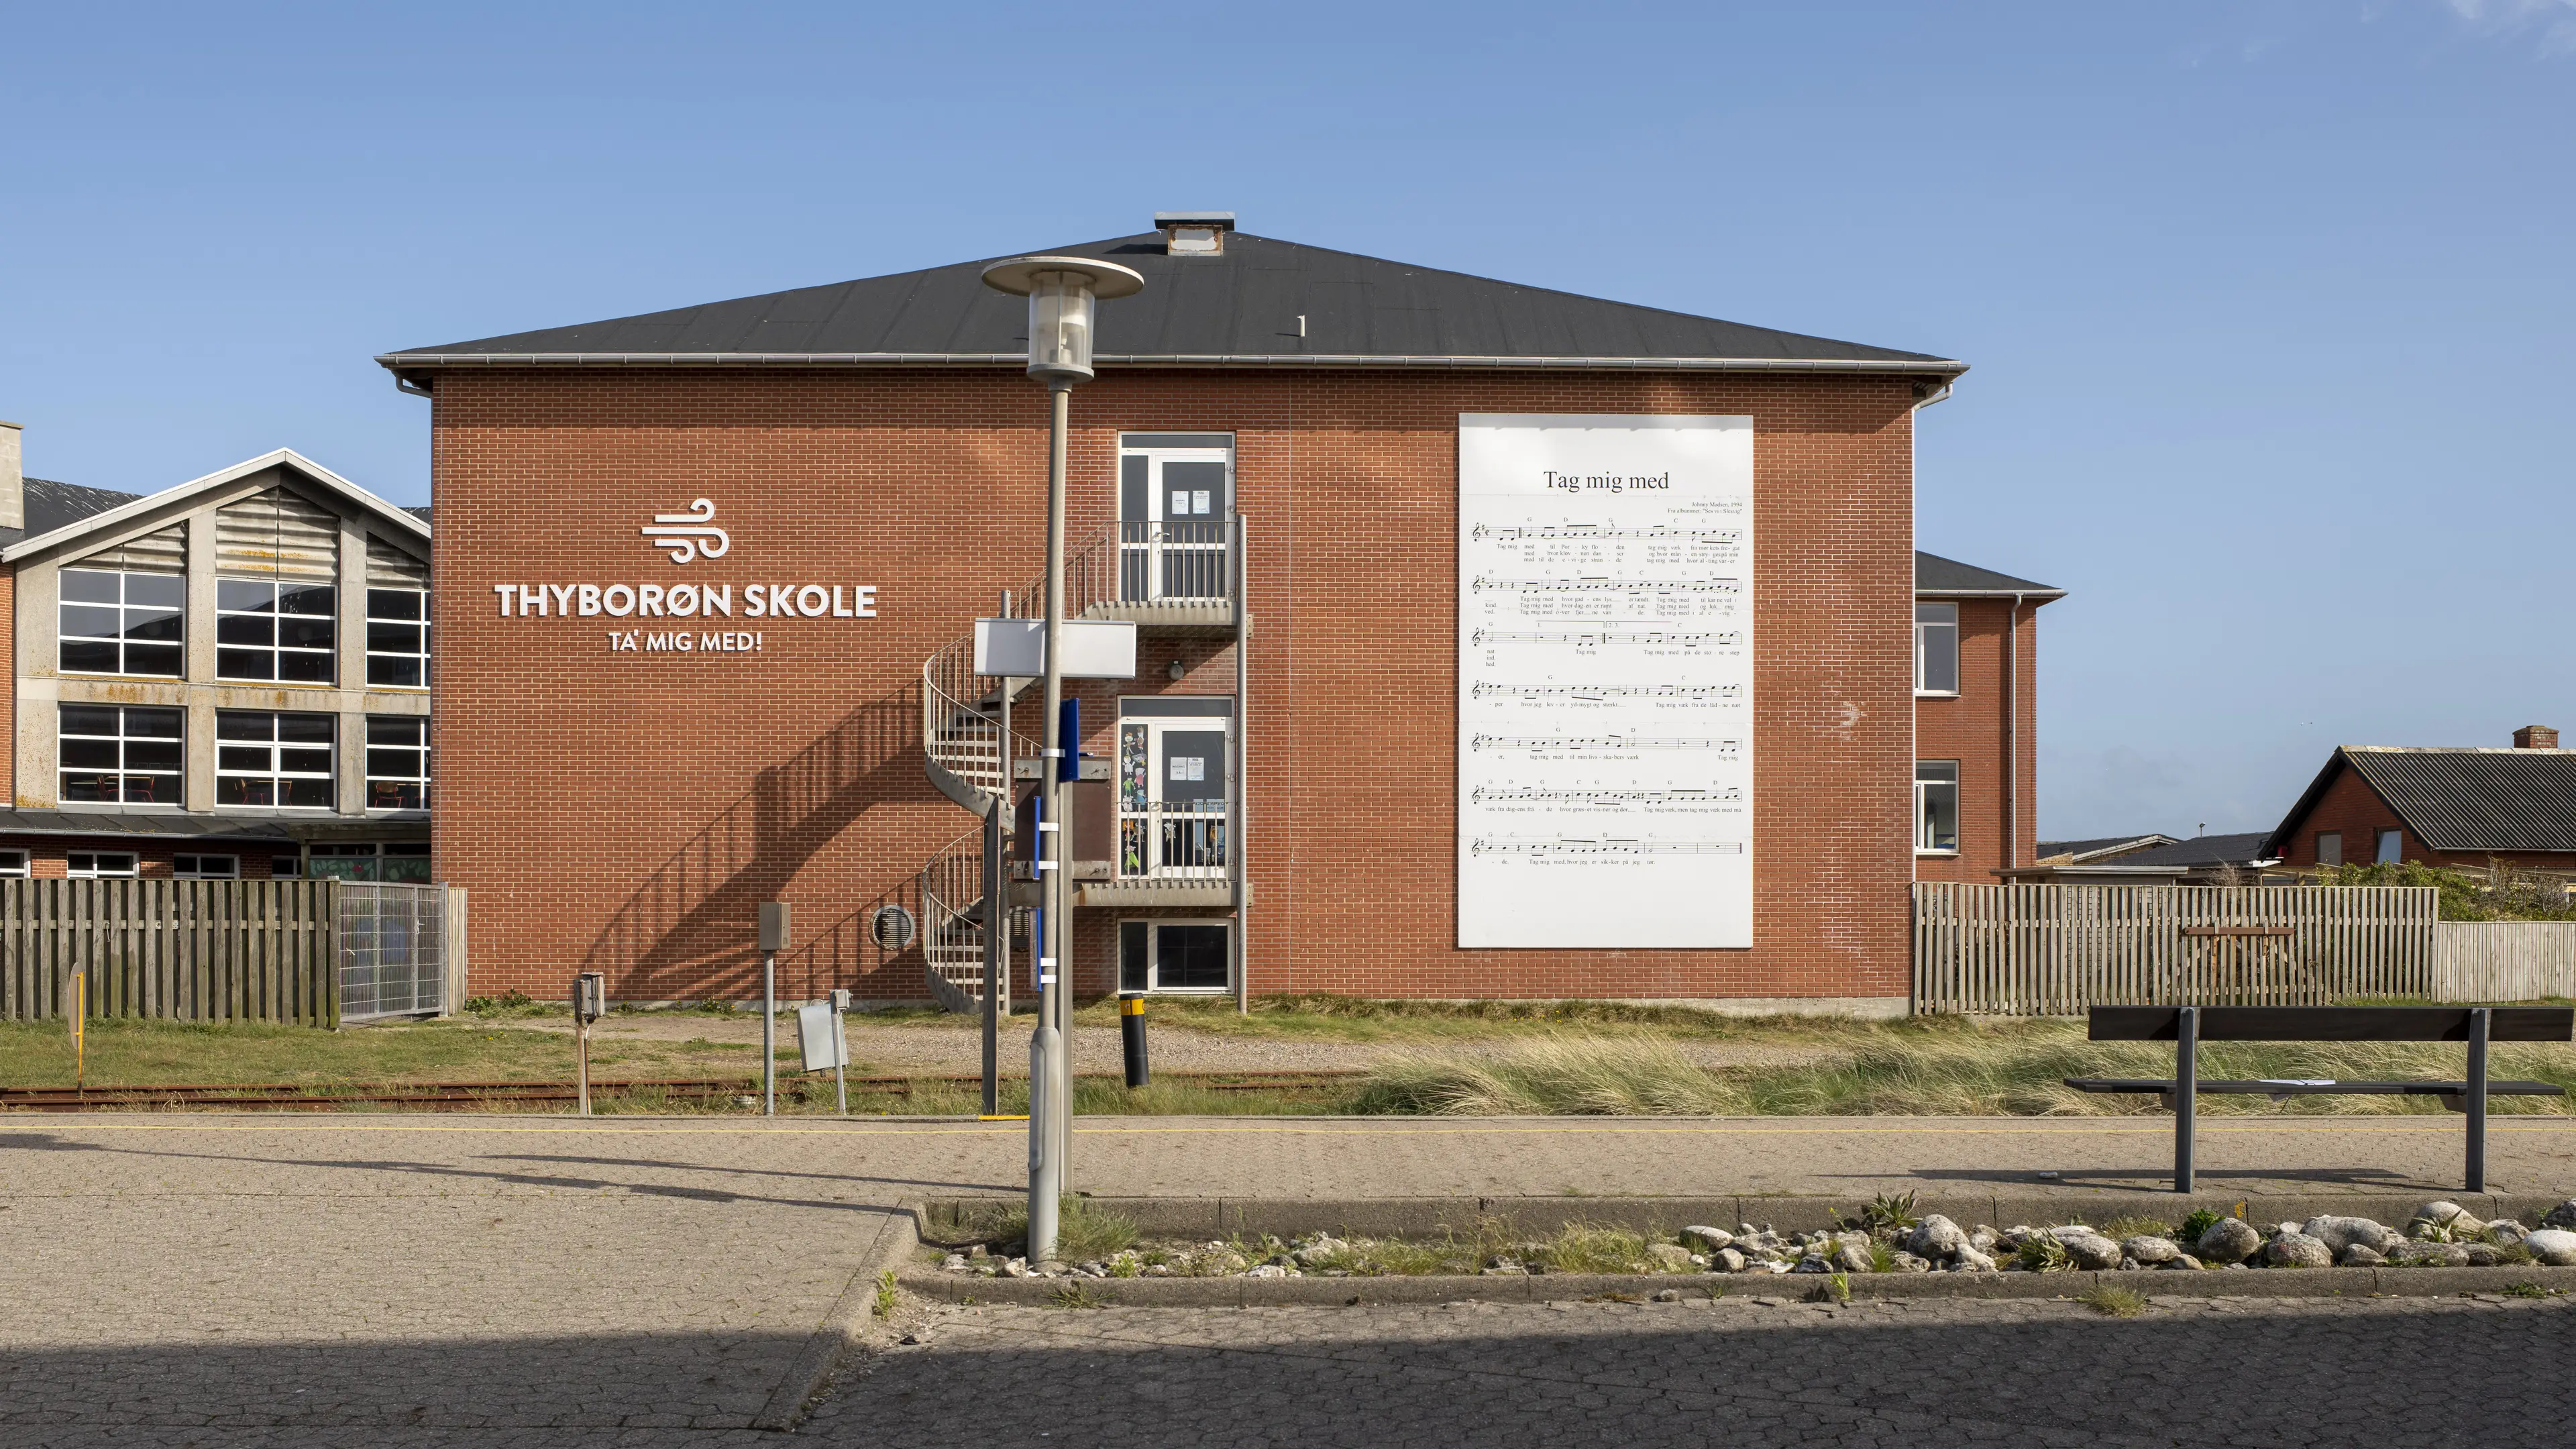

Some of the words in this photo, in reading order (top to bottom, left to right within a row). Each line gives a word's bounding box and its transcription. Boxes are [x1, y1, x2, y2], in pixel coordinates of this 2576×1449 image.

[1544, 472, 1580, 492] Tag
[1587, 472, 1622, 493] mig
[1629, 472, 1669, 488] med
[496, 585, 731, 616] THYBORØN
[746, 585, 877, 617] SKOLE
[647, 633, 692, 651] MIG
[702, 633, 762, 651] MED!
